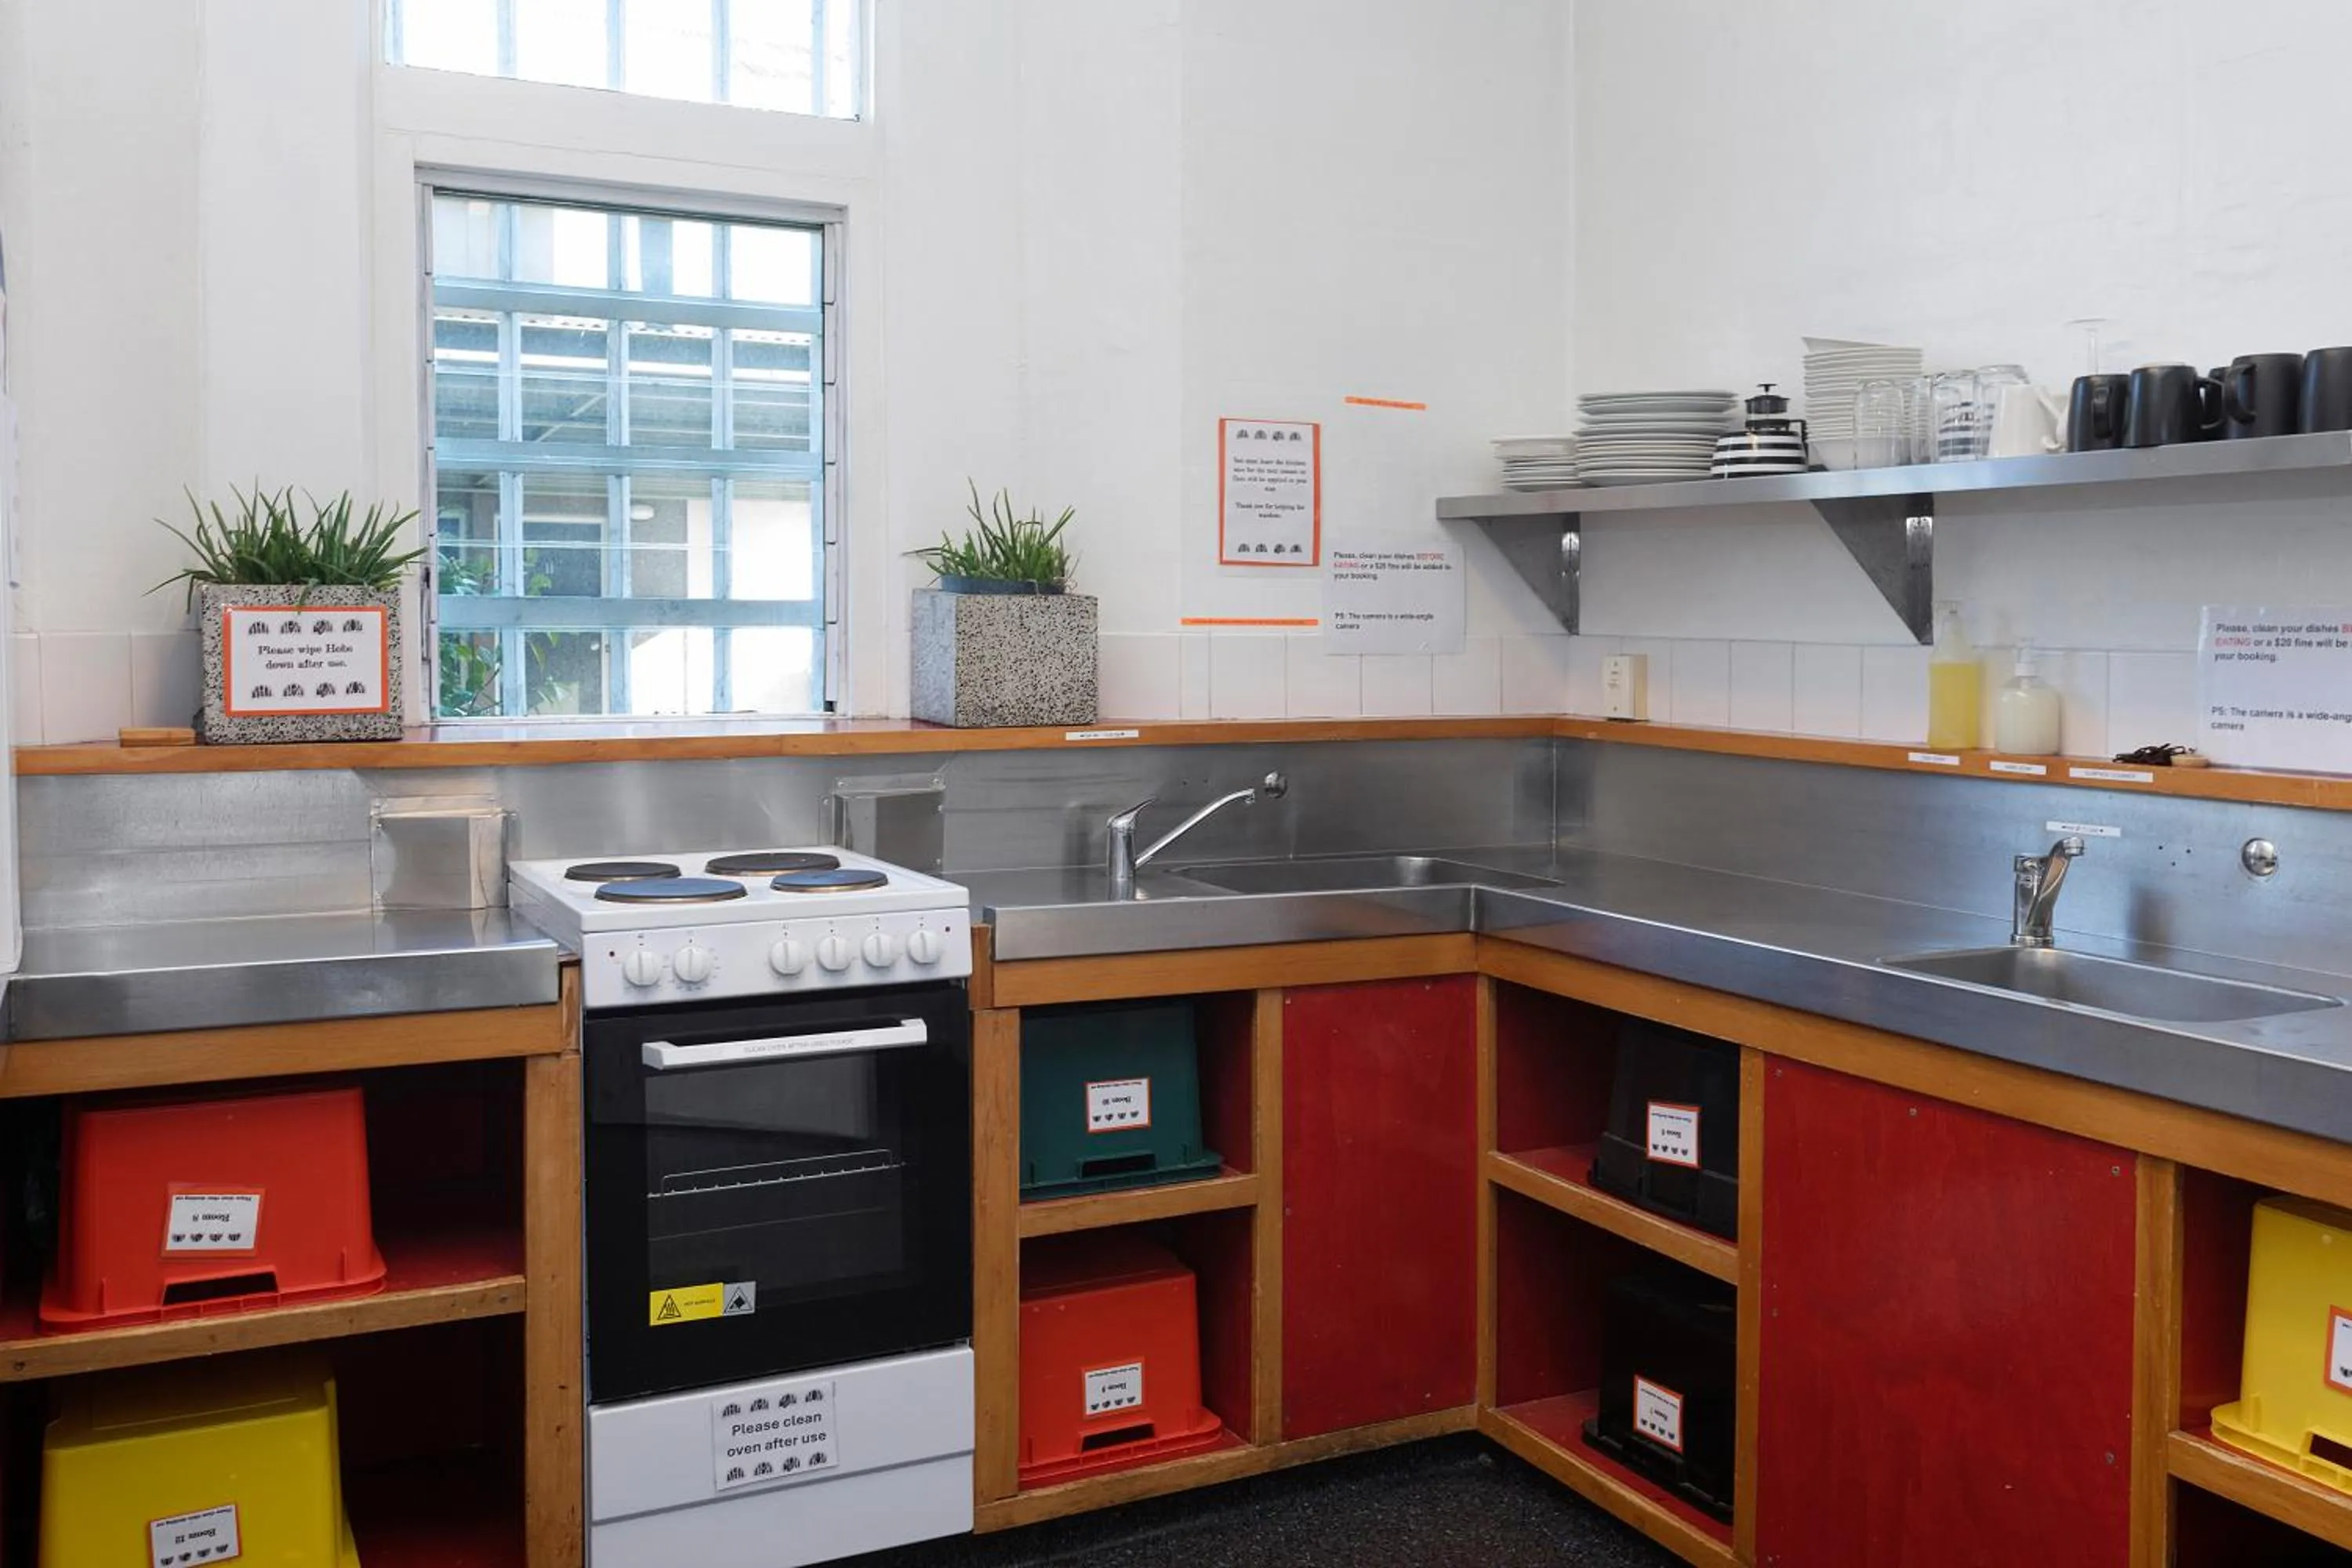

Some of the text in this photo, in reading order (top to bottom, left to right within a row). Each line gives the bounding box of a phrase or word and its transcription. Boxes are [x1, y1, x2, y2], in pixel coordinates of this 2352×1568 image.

[1334, 573, 1349, 582] your
[2252, 624, 2278, 633] clean
[2280, 626, 2303, 635] your
[2306, 624, 2339, 633] dishes
[2253, 638, 2263, 647] or
[2294, 638, 2313, 648] fine
[2316, 639, 2333, 648] will
[2336, 639, 2348, 648] be
[257, 645, 294, 655] Please
[297, 646, 322, 655] wipe
[2214, 652, 2235, 662] your
[266, 659, 294, 670] down
[297, 659, 324, 670] after
[2211, 706, 2227, 717] PS:
[2230, 707, 2247, 717] The
[2249, 710, 2283, 718] camera
[2286, 710, 2295, 719] is
[2211, 721, 2245, 731] camera
[202, 1214, 230, 1222] Room
[731, 1413, 822, 1436] Please clean
[728, 1432, 827, 1457] oven after use
[188, 1528, 216, 1539] Room
